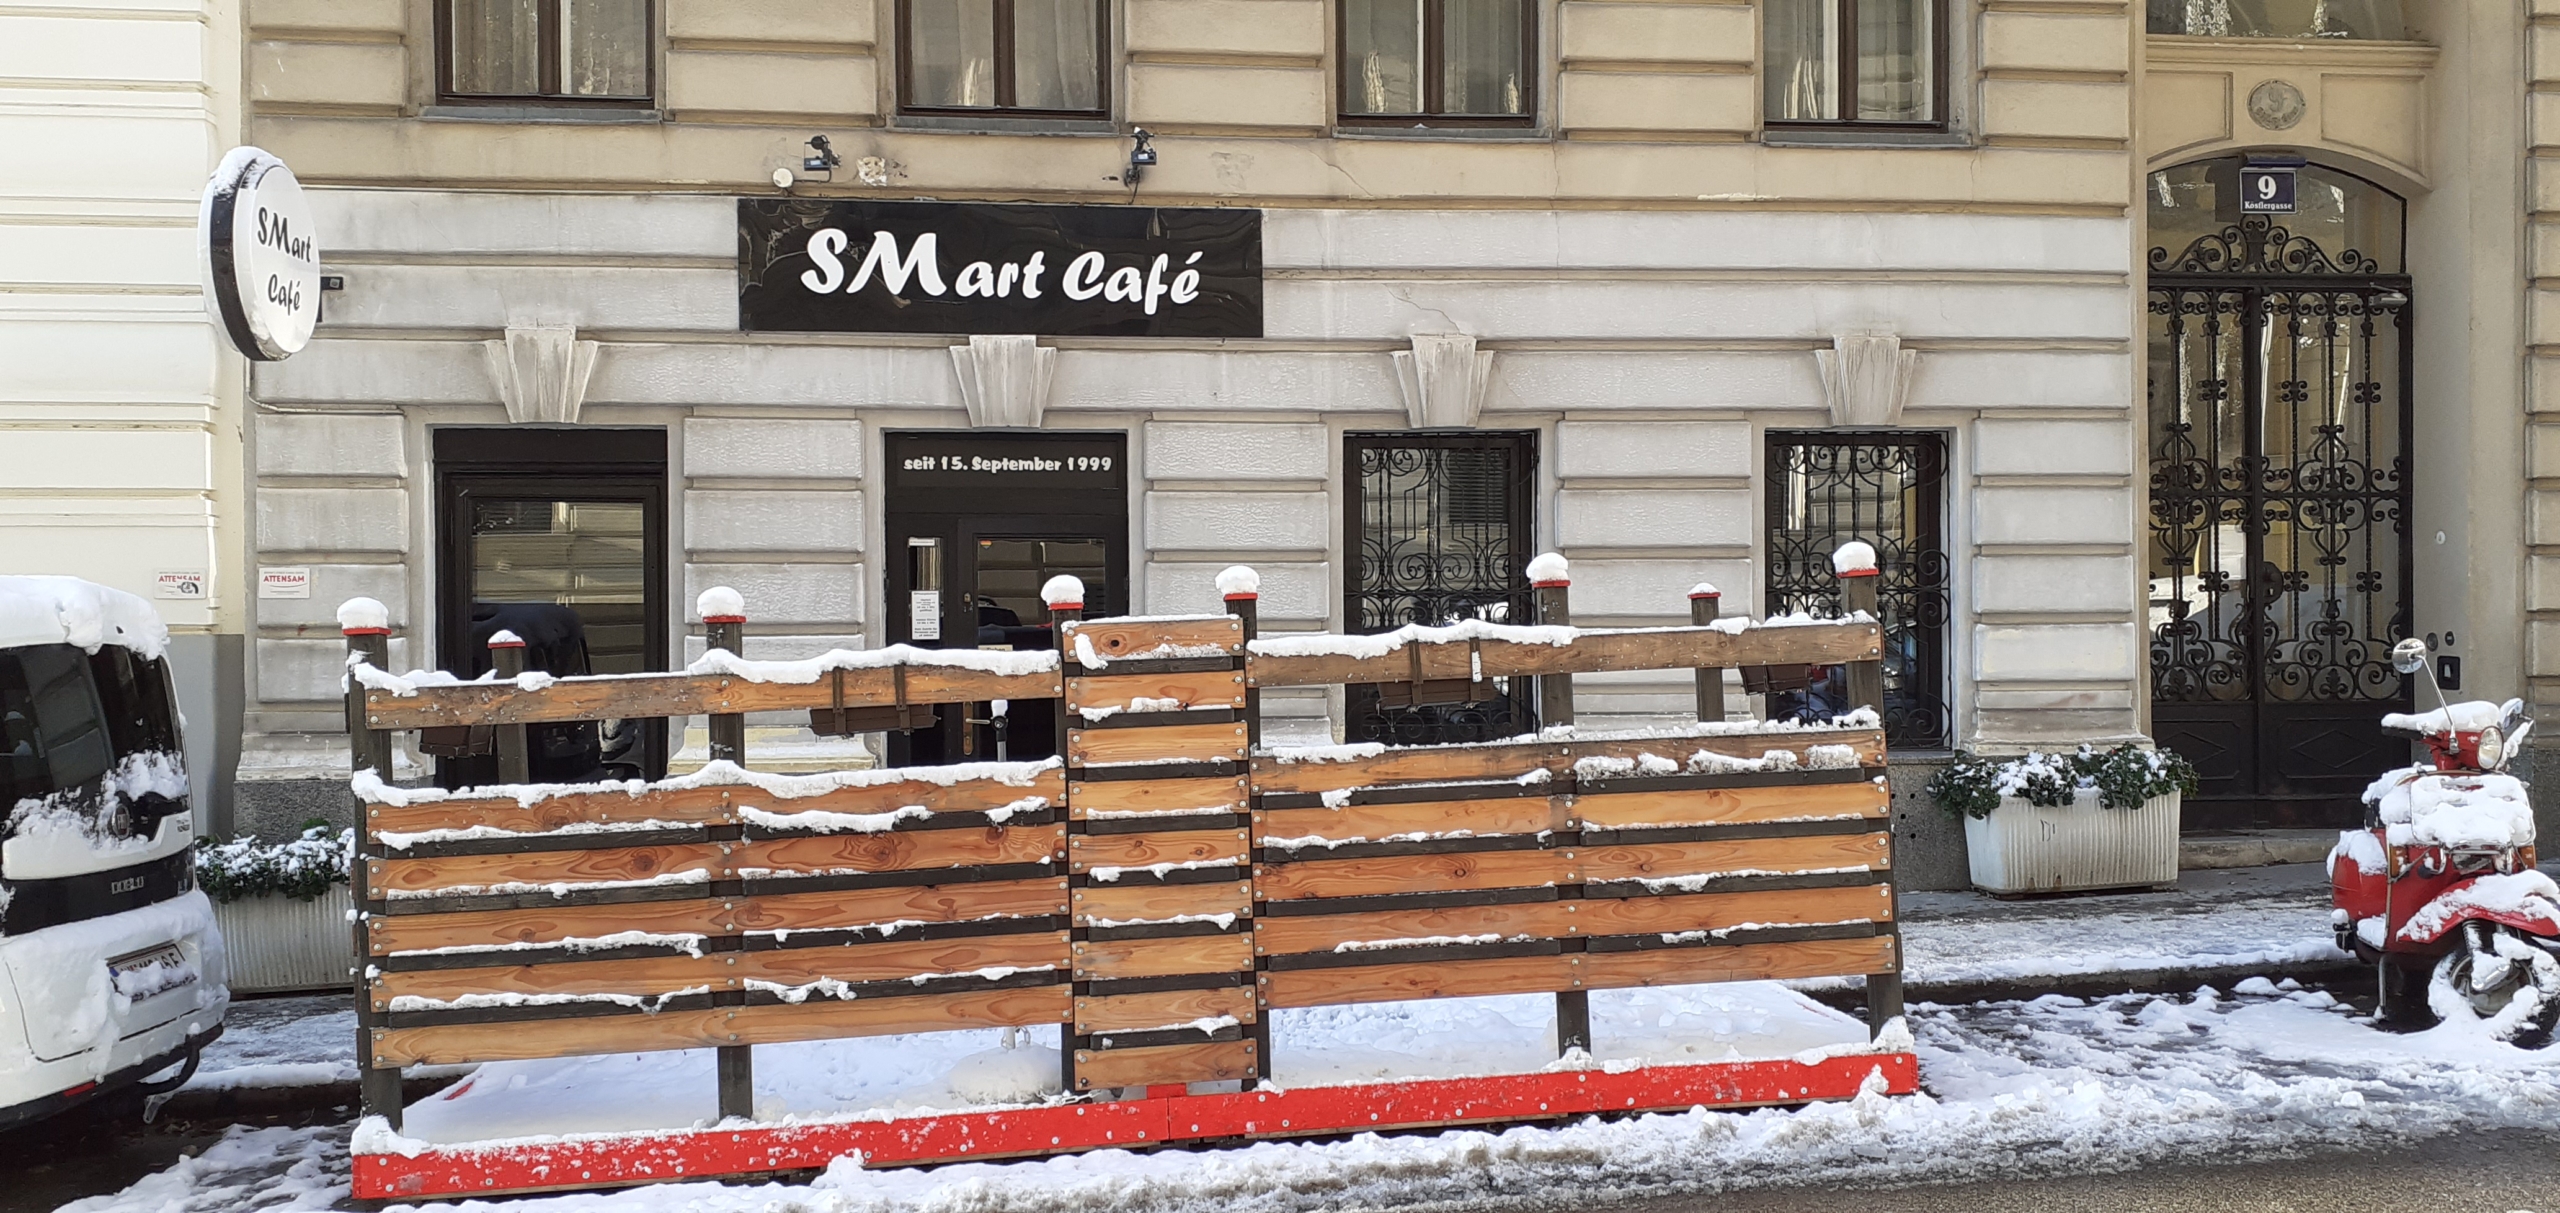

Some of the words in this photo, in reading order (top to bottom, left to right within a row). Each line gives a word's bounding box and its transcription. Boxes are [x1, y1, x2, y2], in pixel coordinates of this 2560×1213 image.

[2257, 175, 2277, 199] 9
[257, 206, 311, 263] SMart
[801, 228, 1045, 300] SMart
[1062, 251, 1203, 315] Café
[268, 273, 301, 315] Café
[903, 456, 935, 471] seit
[941, 456, 969, 471] 15.
[971, 456, 1062, 474] September
[1067, 457, 1112, 472] 1999
[263, 575, 305, 583] ATTENSAM
